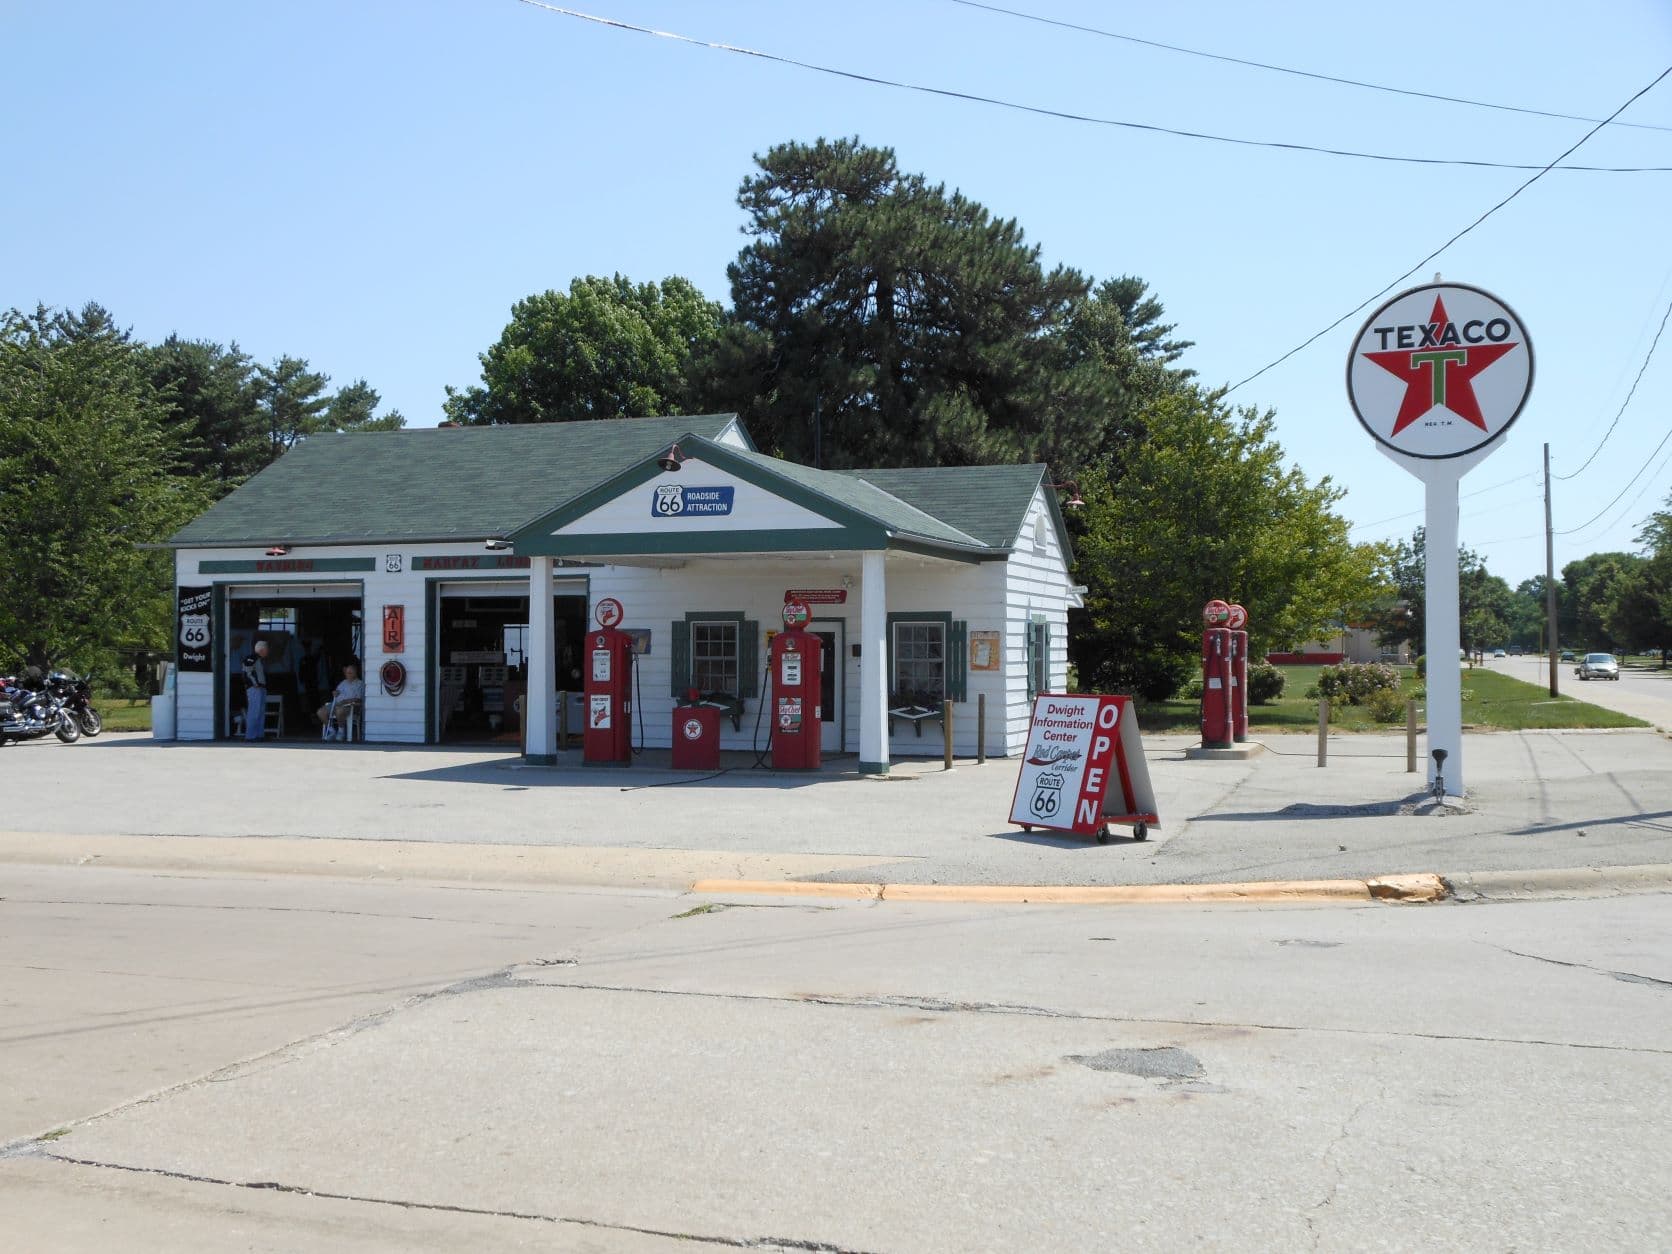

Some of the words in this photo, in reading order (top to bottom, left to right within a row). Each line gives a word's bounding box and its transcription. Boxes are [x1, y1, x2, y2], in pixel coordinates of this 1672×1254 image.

[1374, 318, 1511, 350] TEXACO
[1410, 349, 1467, 407] T
[687, 492, 720, 501] ROADSIDE
[659, 495, 680, 513] 66
[687, 503, 728, 512] ATTRACTION
[389, 561, 399, 570] 66
[387, 609, 400, 642] AIR
[185, 628, 204, 642] 66
[183, 652, 206, 663] Dwight
[1047, 704, 1085, 717] Dwight
[1033, 717, 1093, 730] Information
[1043, 730, 1078, 742] Center
[1051, 763, 1078, 772] Corridor
[1078, 704, 1119, 825] OPEN
[1039, 777, 1061, 787] ROUTE
[1034, 790, 1056, 813] 66
